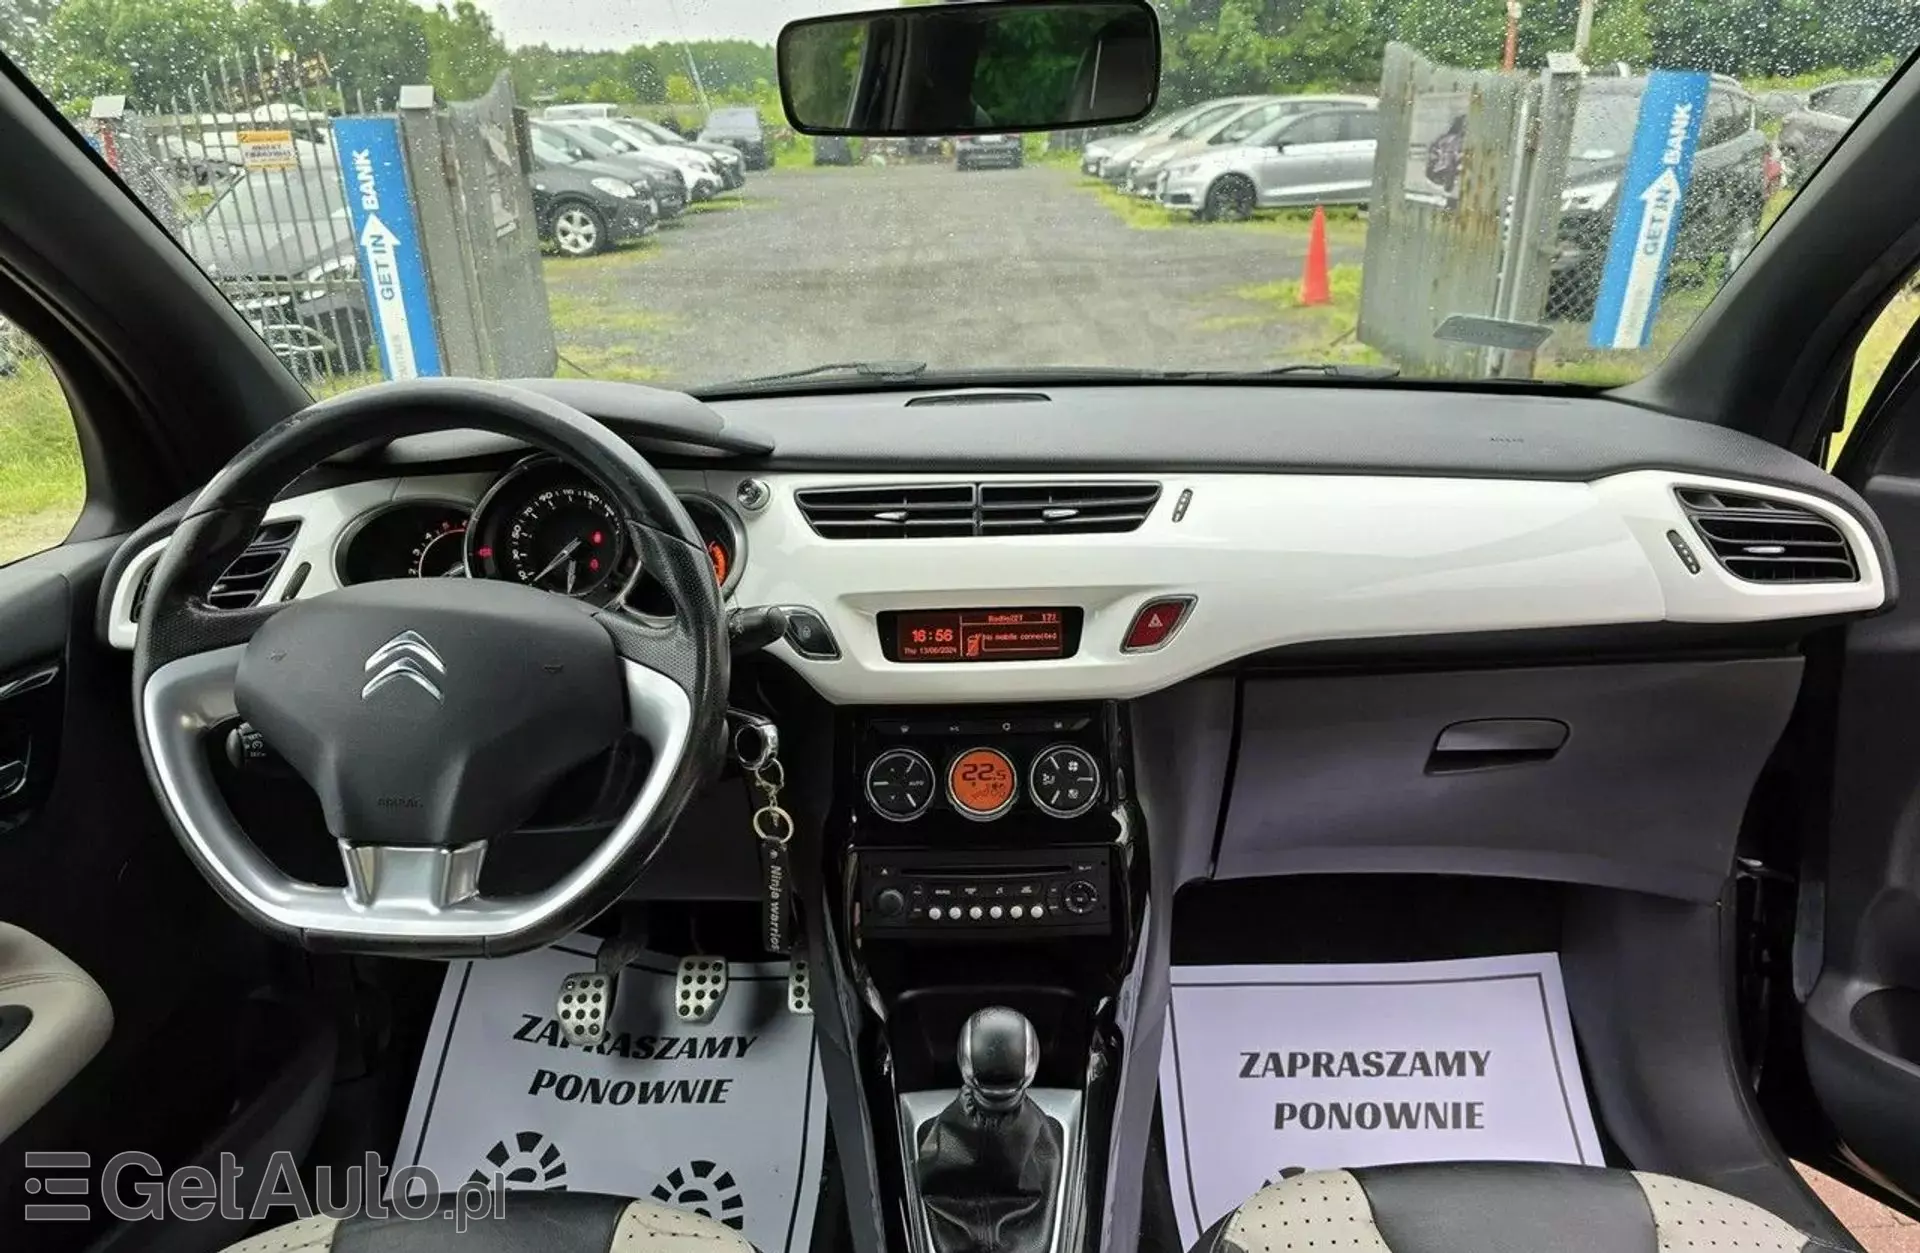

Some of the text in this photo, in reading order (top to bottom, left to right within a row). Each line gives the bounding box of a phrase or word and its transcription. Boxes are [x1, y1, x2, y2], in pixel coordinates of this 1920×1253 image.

[1663, 102, 1692, 165] BANK
[352, 148, 396, 301] GET IN BANK
[911, 628, 953, 643] 16:56
[769, 865, 782, 899] Ninja
[513, 1014, 757, 1060] ZARASZAMY
[1239, 1050, 1492, 1079] ZAPRASZAMY
[528, 1069, 733, 1106] PONOWNIE
[1274, 1101, 1486, 1131] PONOWNIE
